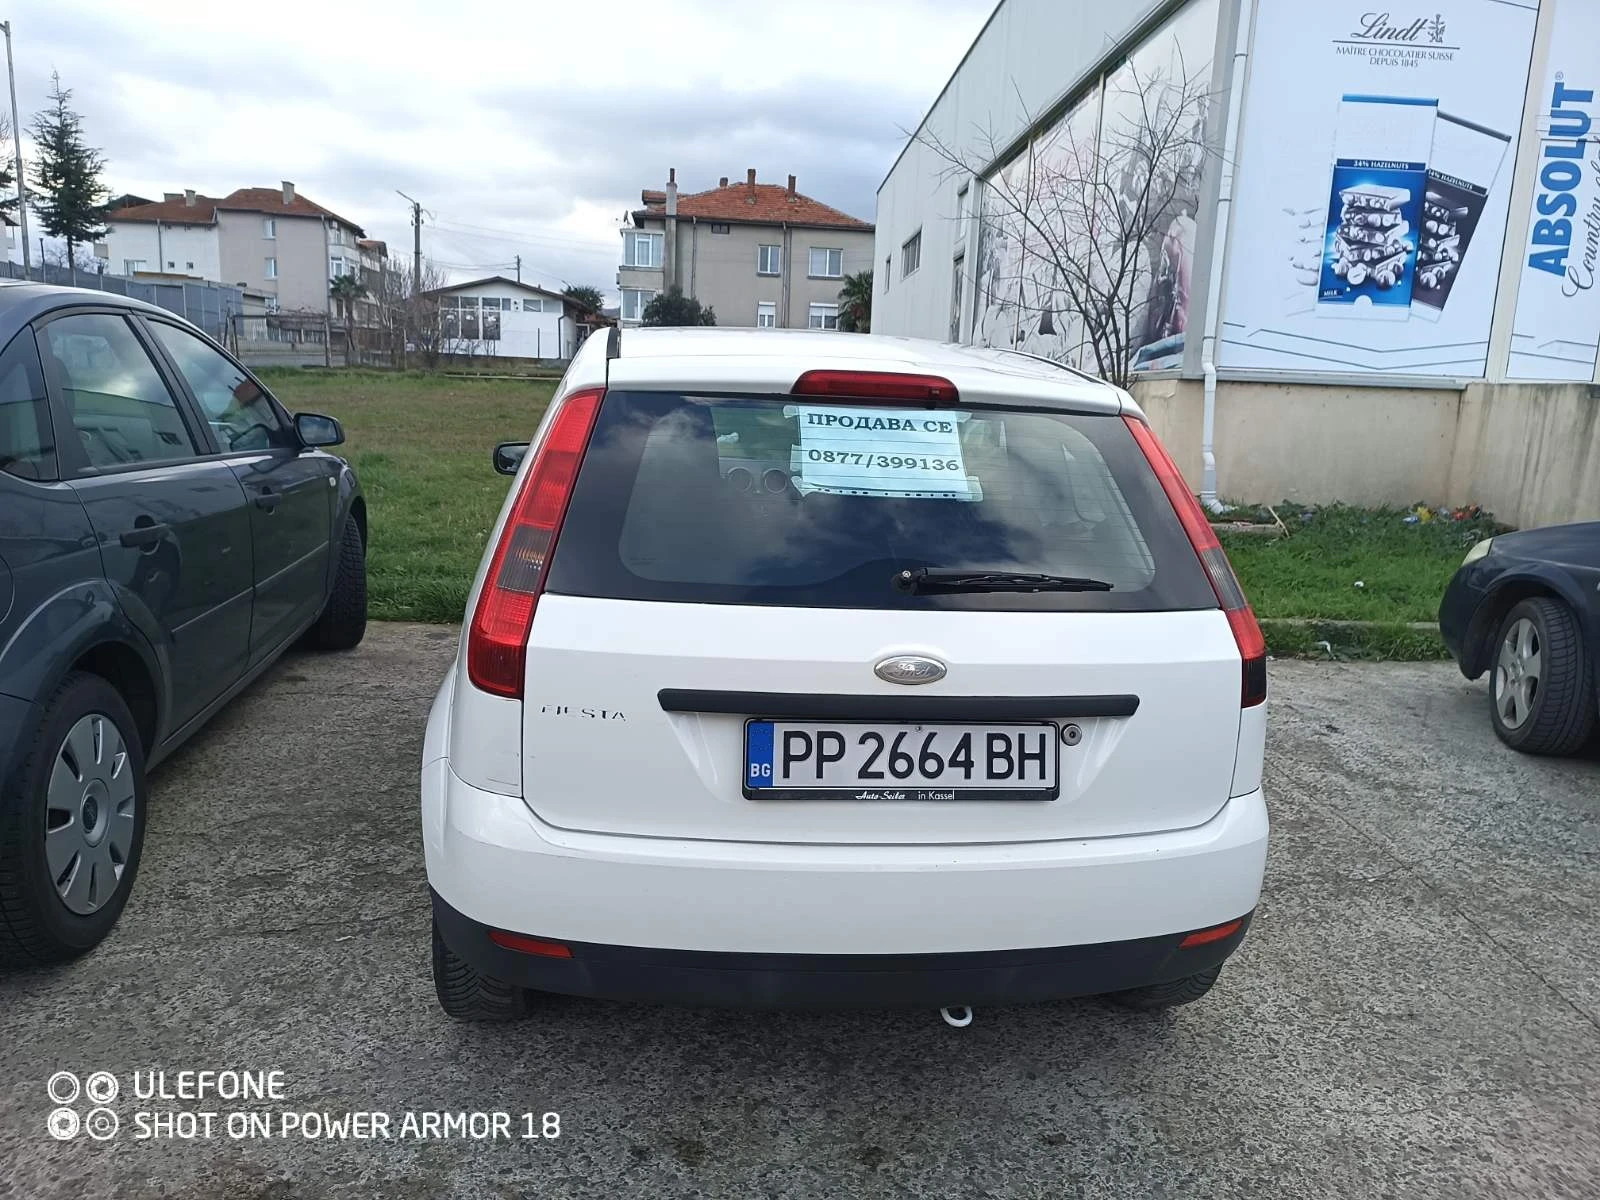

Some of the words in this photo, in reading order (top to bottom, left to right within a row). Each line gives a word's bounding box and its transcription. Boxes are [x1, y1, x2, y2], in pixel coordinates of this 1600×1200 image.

[1350, 12, 1428, 41] Lindt
[1369, 56, 1399, 67] DEPUIS
[807, 412, 916, 432] ПРОДАВА
[923, 420, 953, 434] СЕ
[808, 449, 960, 472] 0877/399136
[782, 730, 846, 779] PP
[857, 731, 975, 780] 2664
[986, 732, 1047, 780] BH
[750, 763, 771, 777] BG
[918, 791, 926, 800] in
[928, 789, 955, 800] Kassel
